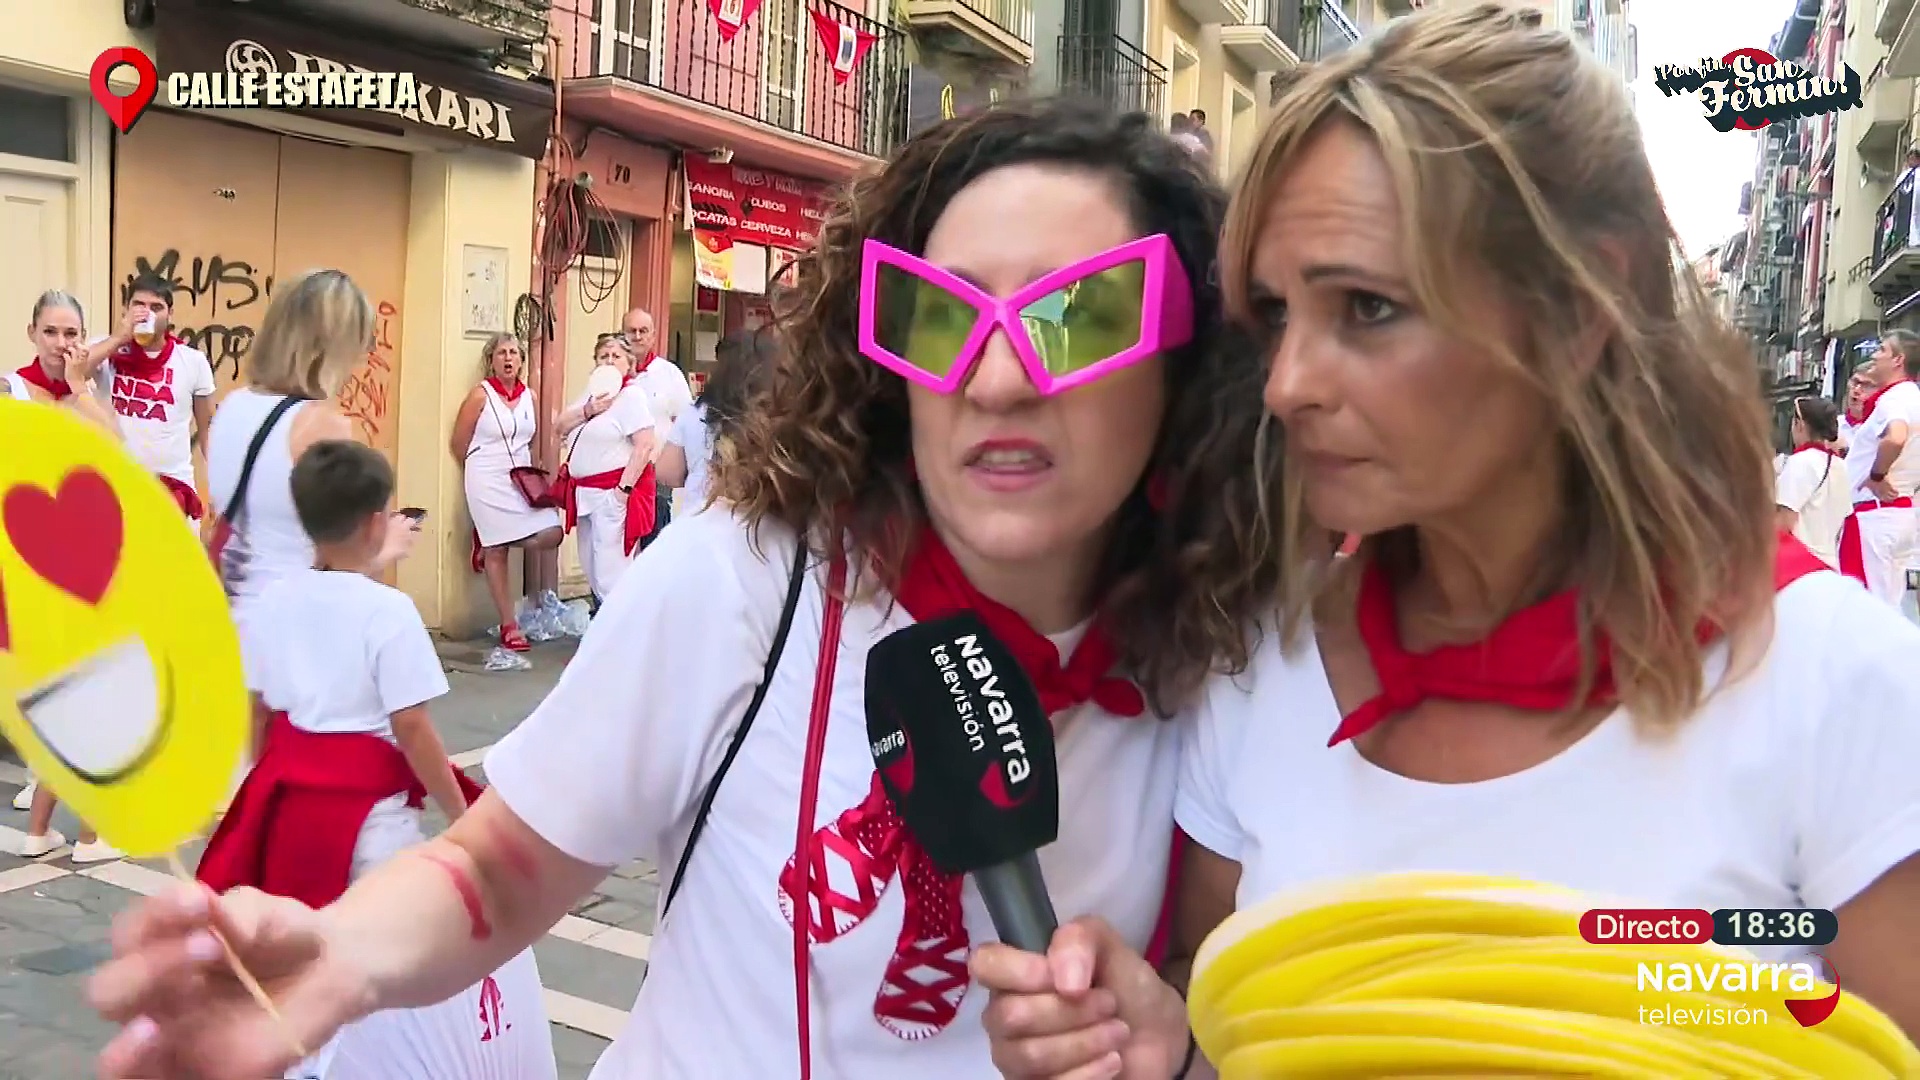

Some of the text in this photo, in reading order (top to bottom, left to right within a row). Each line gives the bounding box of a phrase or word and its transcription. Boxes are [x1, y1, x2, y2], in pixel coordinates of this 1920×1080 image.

[614, 163, 631, 184] 70
[740, 220, 792, 238] CERVEZA
[930, 644, 986, 752] televisión
[954, 634, 1031, 784] Navarra
